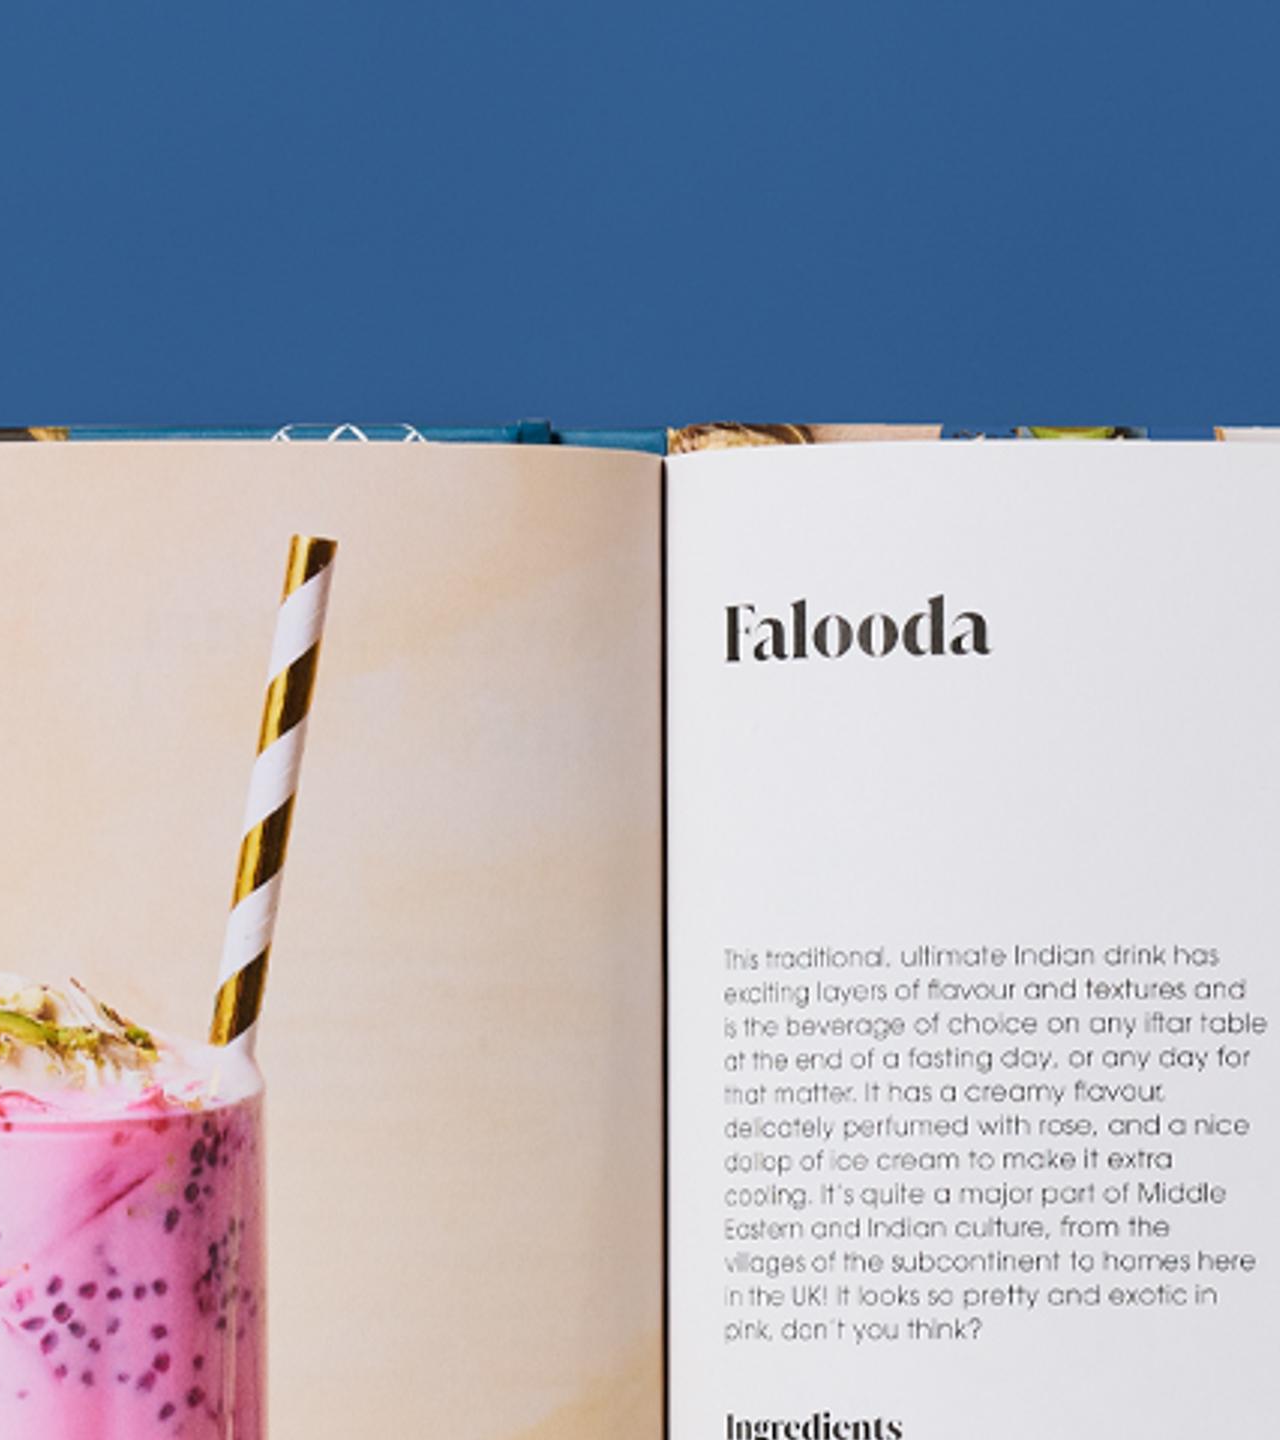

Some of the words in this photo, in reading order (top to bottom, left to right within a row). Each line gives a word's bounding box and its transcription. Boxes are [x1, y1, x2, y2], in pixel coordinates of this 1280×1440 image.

[724, 594, 992, 664] Falooda
[724, 948, 759, 971] This
[766, 945, 891, 971] traditional,
[900, 944, 1007, 969] ultimate
[1015, 943, 1096, 968] Indian
[1102, 944, 1166, 968] drink
[1173, 944, 1220, 968] has
[724, 1017, 737, 1040] is
[743, 1016, 779, 1039] the
[785, 1015, 906, 1042] beverage
[913, 1011, 940, 1037] of
[946, 1011, 1038, 1037] choice
[1046, 1015, 1080, 1037] on
[1088, 1015, 1137, 1040] any
[1144, 1010, 1193, 1037] iftar
[1200, 1010, 1268, 1037] table
[724, 1050, 746, 1072] at
[751, 1049, 788, 1073] the
[795, 1047, 843, 1073] end
[850, 1046, 876, 1071] of
[882, 1050, 899, 1070] a
[907, 1045, 993, 1075] fasting
[1000, 1045, 1059, 1073] day,
[1067, 1048, 1096, 1070] or
[1102, 1049, 1151, 1072] any
[1158, 1045, 1210, 1073] day
[1216, 1043, 1251, 1070] for
[724, 1217, 804, 1240] Eastern
[811, 1216, 864, 1241] and
[868, 1216, 948, 1241] Indian
[955, 1215, 1051, 1241] culture,
[1060, 1214, 1121, 1241] from
[1126, 1214, 1171, 1238] the
[852, 1322, 899, 1346] you
[907, 1316, 983, 1340] think?
